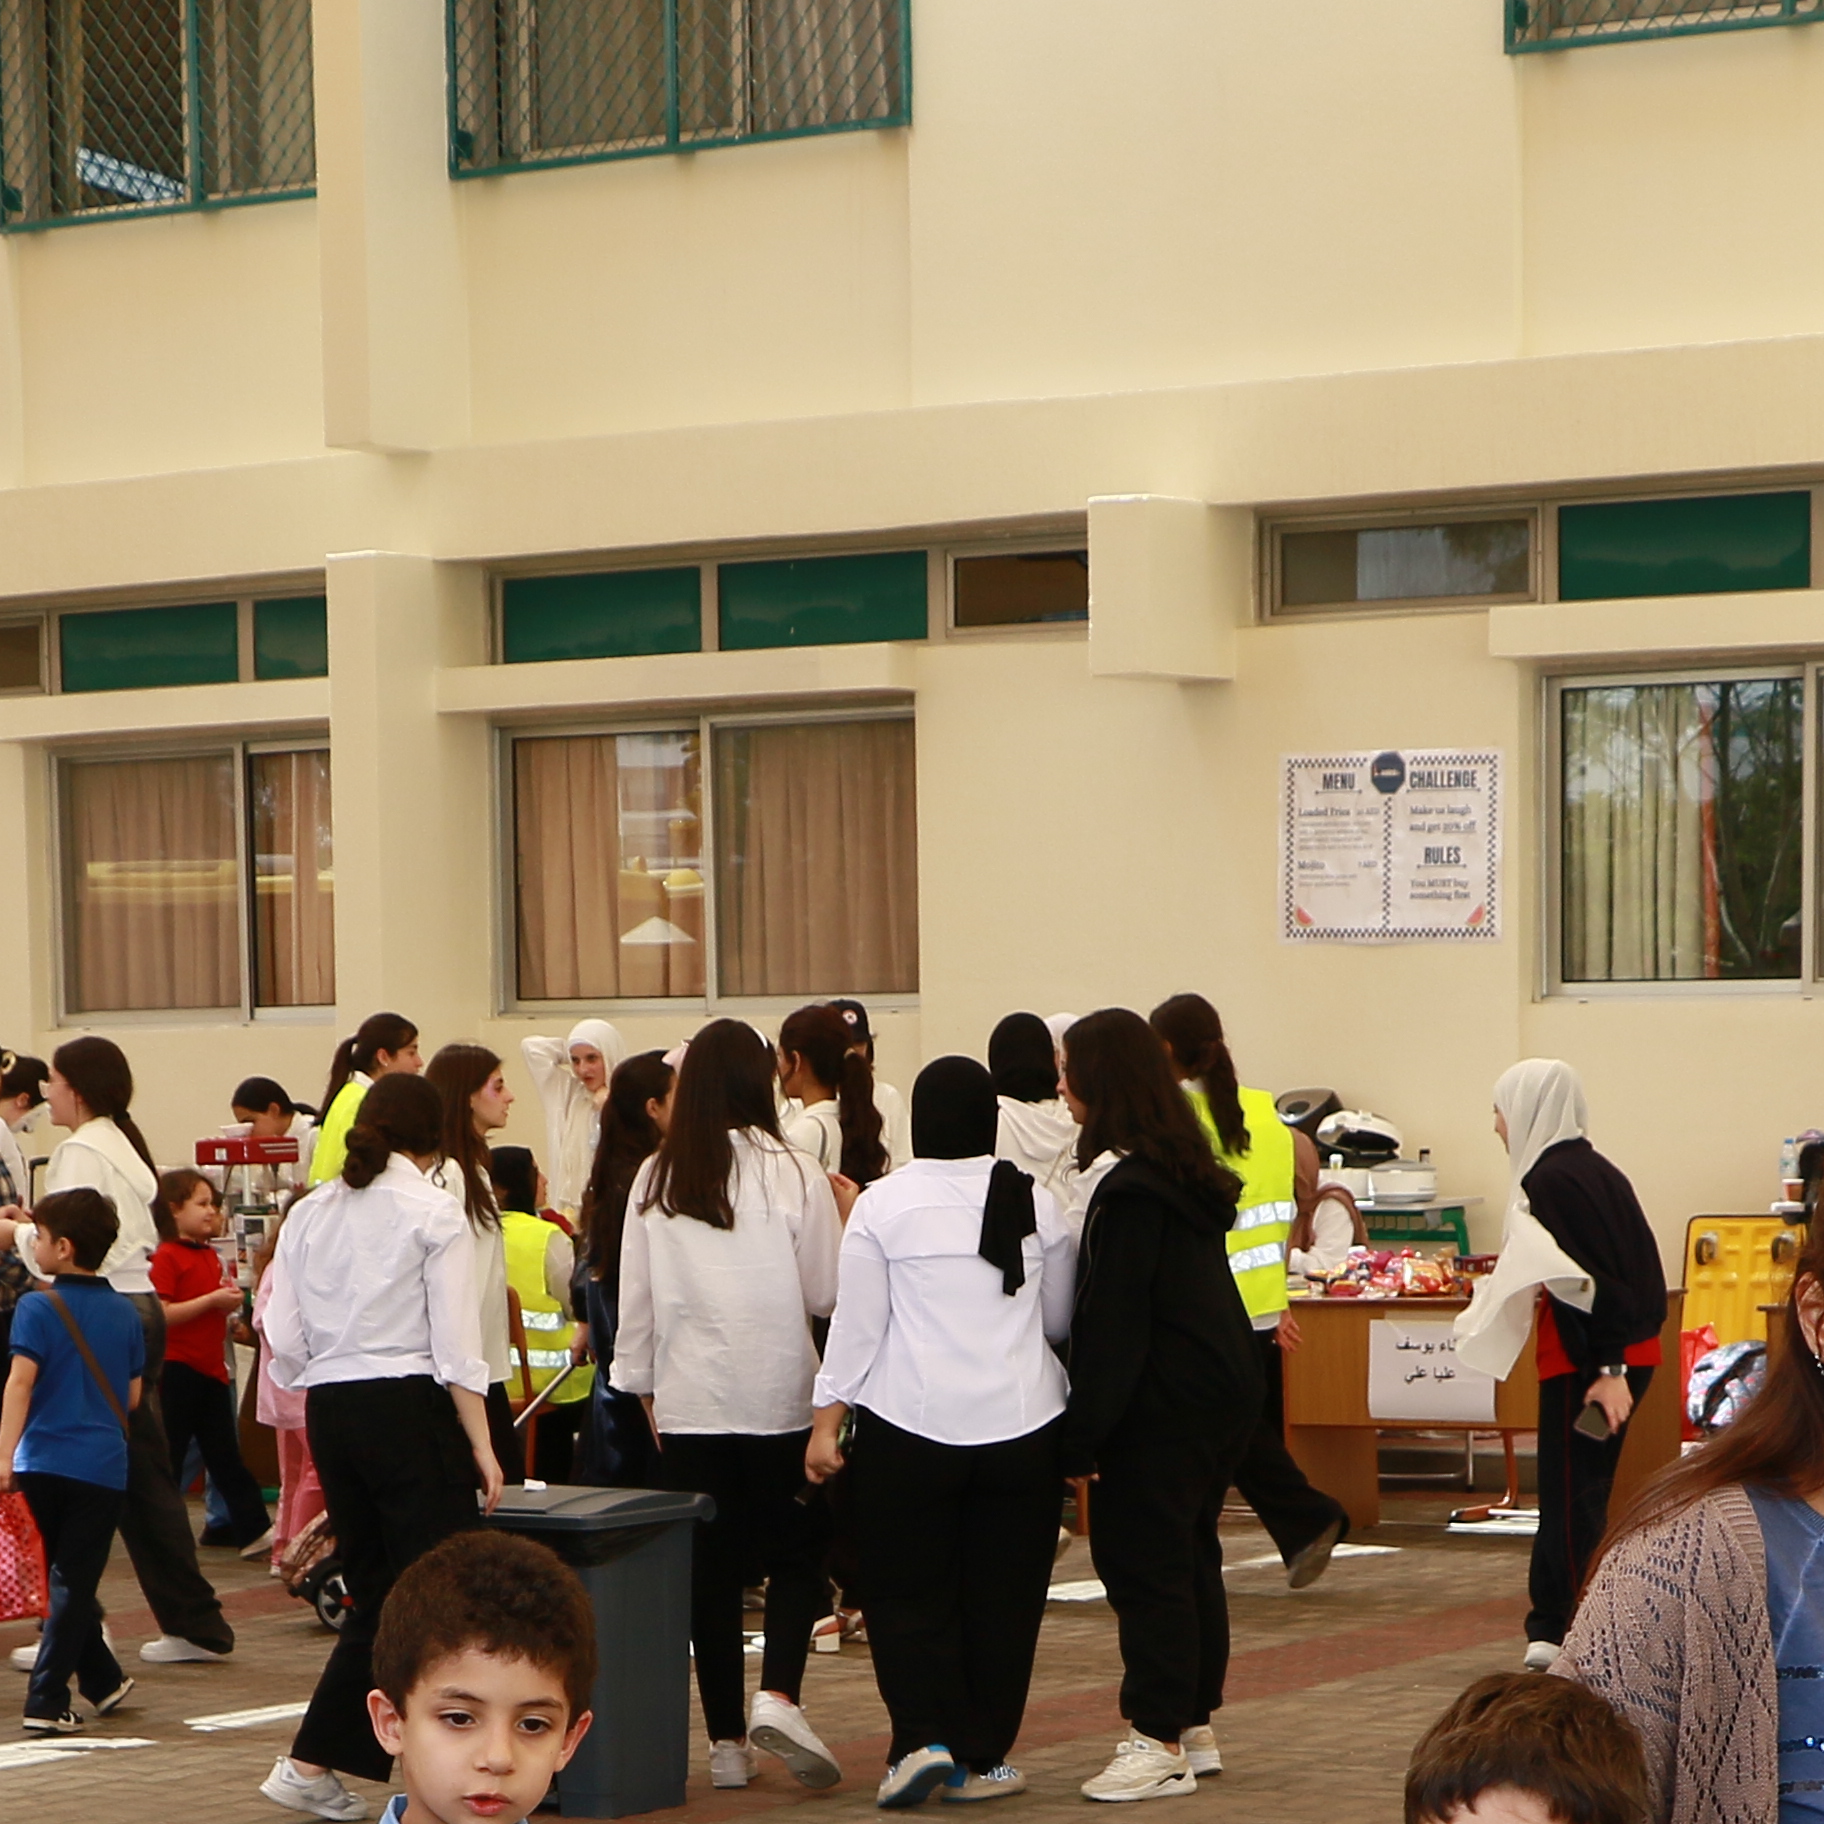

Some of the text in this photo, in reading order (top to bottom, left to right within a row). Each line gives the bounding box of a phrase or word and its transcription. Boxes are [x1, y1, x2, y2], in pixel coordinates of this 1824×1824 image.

[1322, 773, 1355, 790] MENU
[1409, 769, 1477, 789] CHALLENGE
[1298, 807, 1351, 816] Loaded Fries
[1410, 806, 1433, 815] Make
[1447, 805, 1471, 817] laugh
[1409, 822, 1425, 831] and
[1427, 824, 1441, 834] get
[1463, 821, 1476, 831] off
[1424, 847, 1461, 864] RULES
[1297, 860, 1325, 870] Mojito
[1410, 879, 1425, 888] You
[1453, 878, 1469, 889] buy
[1409, 890, 1470, 900] something first
[1396, 1336, 1434, 1354] يوسف
[1404, 1365, 1455, 1385] عليا علي
